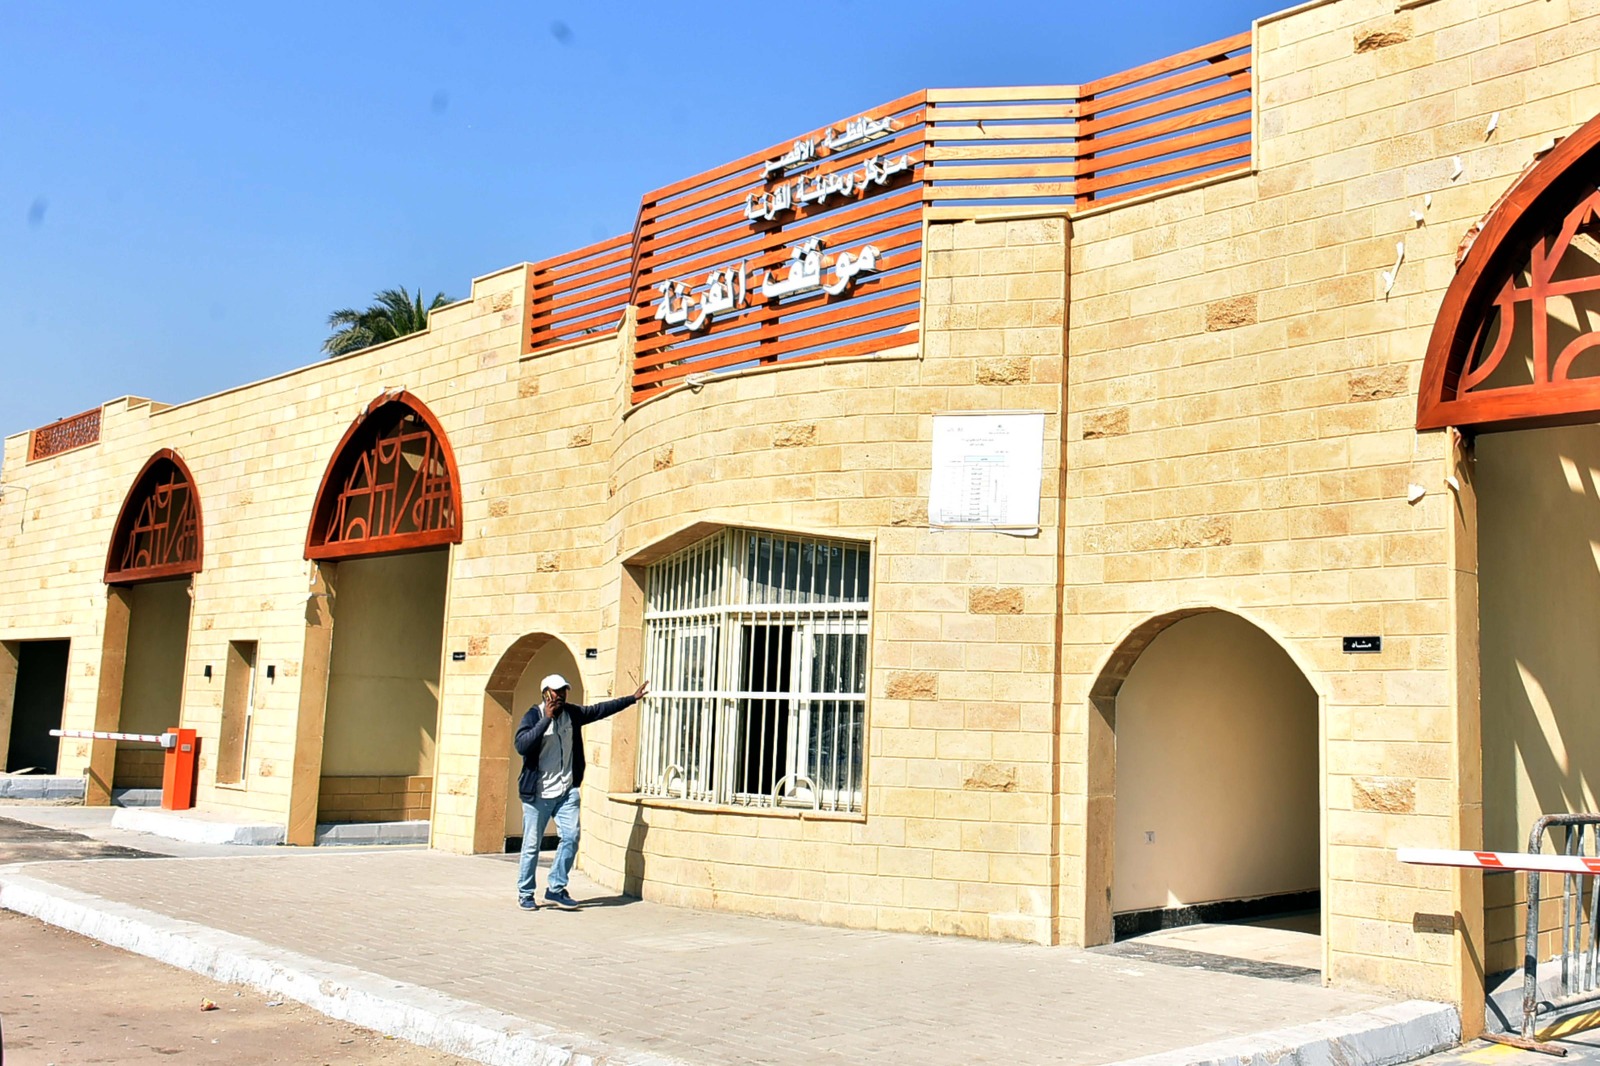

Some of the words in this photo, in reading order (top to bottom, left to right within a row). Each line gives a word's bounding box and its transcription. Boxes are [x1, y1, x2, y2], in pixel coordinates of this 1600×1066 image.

[822, 116, 894, 149] محافظة
[796, 173, 855, 204] ومدينة
[855, 154, 909, 190] مركز
[744, 183, 791, 220] القرنة
[762, 236, 880, 297] موقف
[654, 261, 746, 331] القرنة
